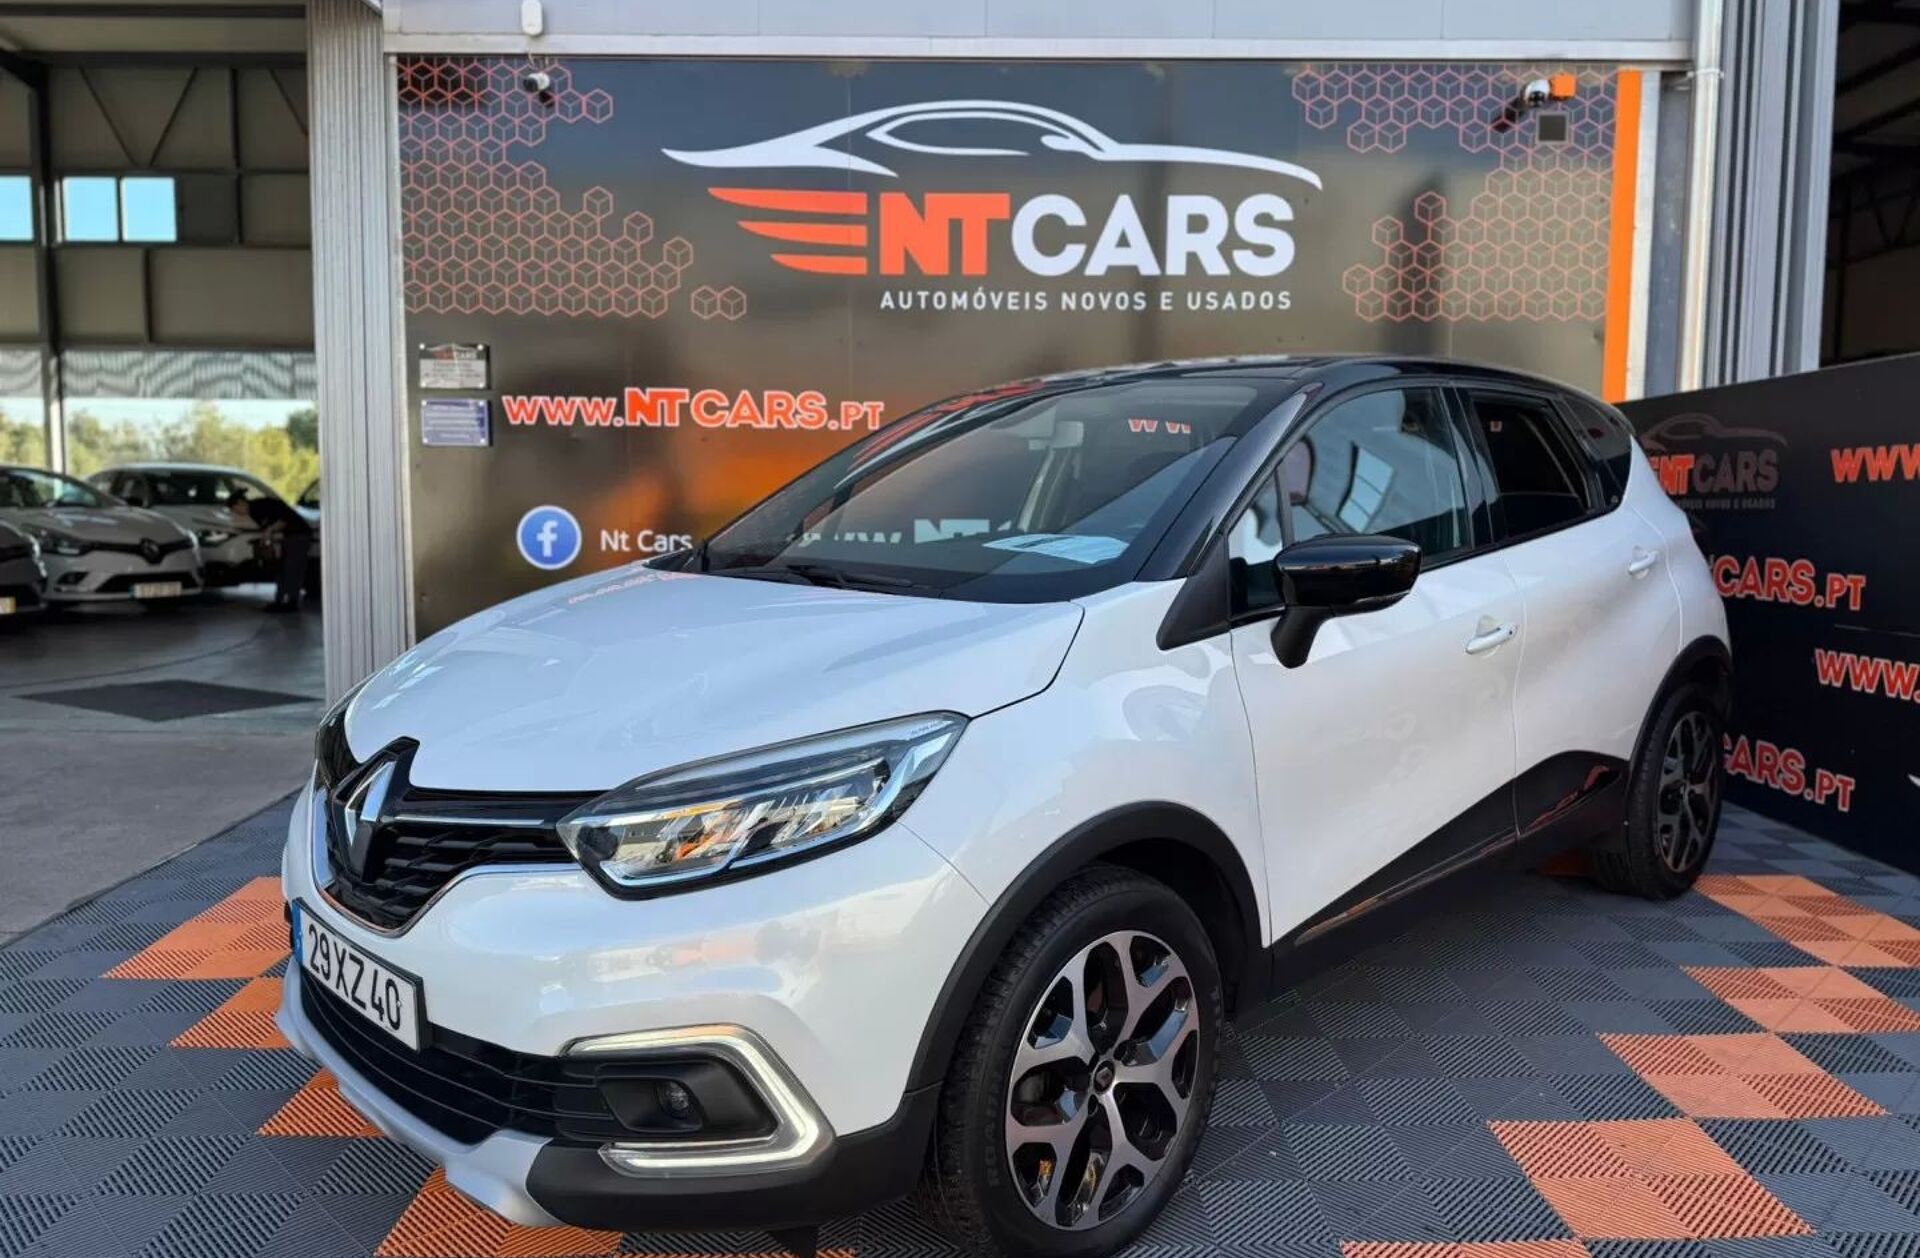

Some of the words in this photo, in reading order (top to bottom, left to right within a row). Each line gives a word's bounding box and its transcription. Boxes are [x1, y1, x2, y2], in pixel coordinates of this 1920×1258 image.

[879, 192, 1295, 276] NTCARS
[880, 287, 1047, 310] AUTOMÓVEIS
[1061, 291, 1146, 310] NOVOS
[1161, 291, 1173, 310] E
[1187, 290, 1291, 310] USADOS
[600, 529, 630, 552] Nt
[637, 530, 694, 552] Cars
[1710, 554, 1866, 611] CARS.PT
[308, 923, 401, 1031] 29XZ40
